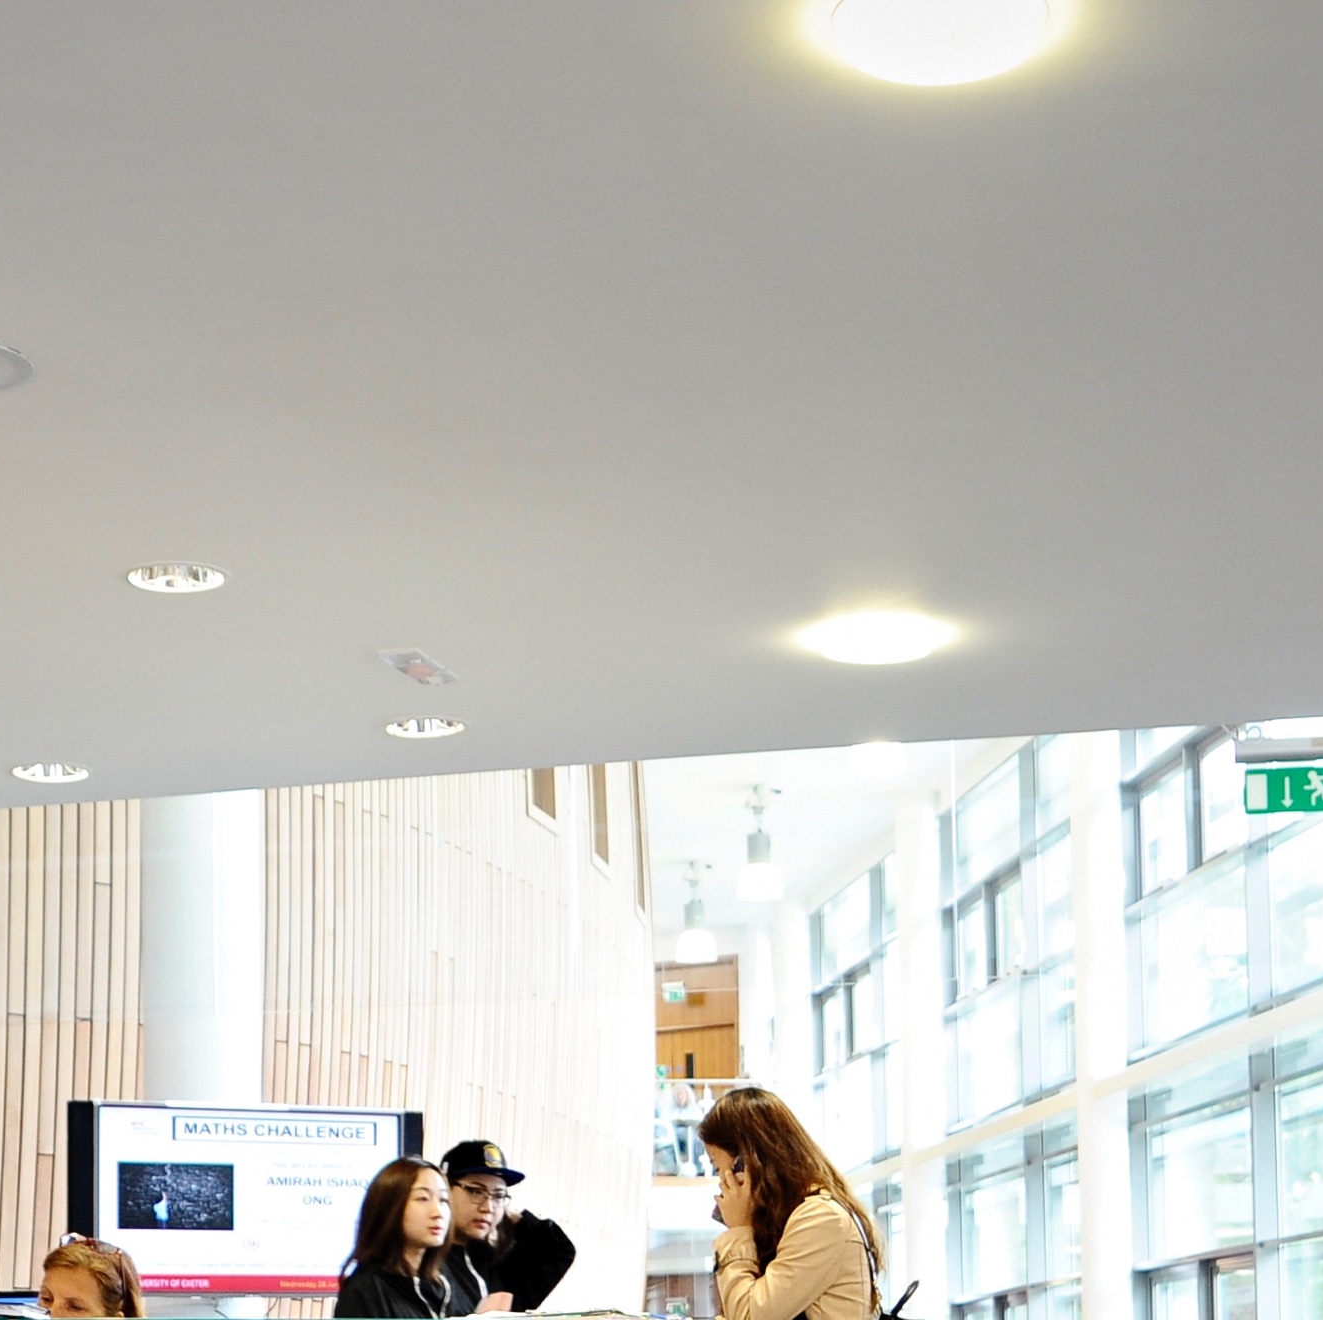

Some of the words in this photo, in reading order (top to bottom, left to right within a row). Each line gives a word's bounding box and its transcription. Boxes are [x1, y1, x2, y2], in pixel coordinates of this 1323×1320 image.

[184, 1122, 248, 1137] MATHS
[255, 1123, 366, 1139] CHALLENGE
[266, 1176, 322, 1188] AMIRAH
[303, 1195, 332, 1206] ONG
[169, 1280, 180, 1289] OF
[181, 1280, 209, 1289] EXETER
[279, 1280, 315, 1289] Wednesday
